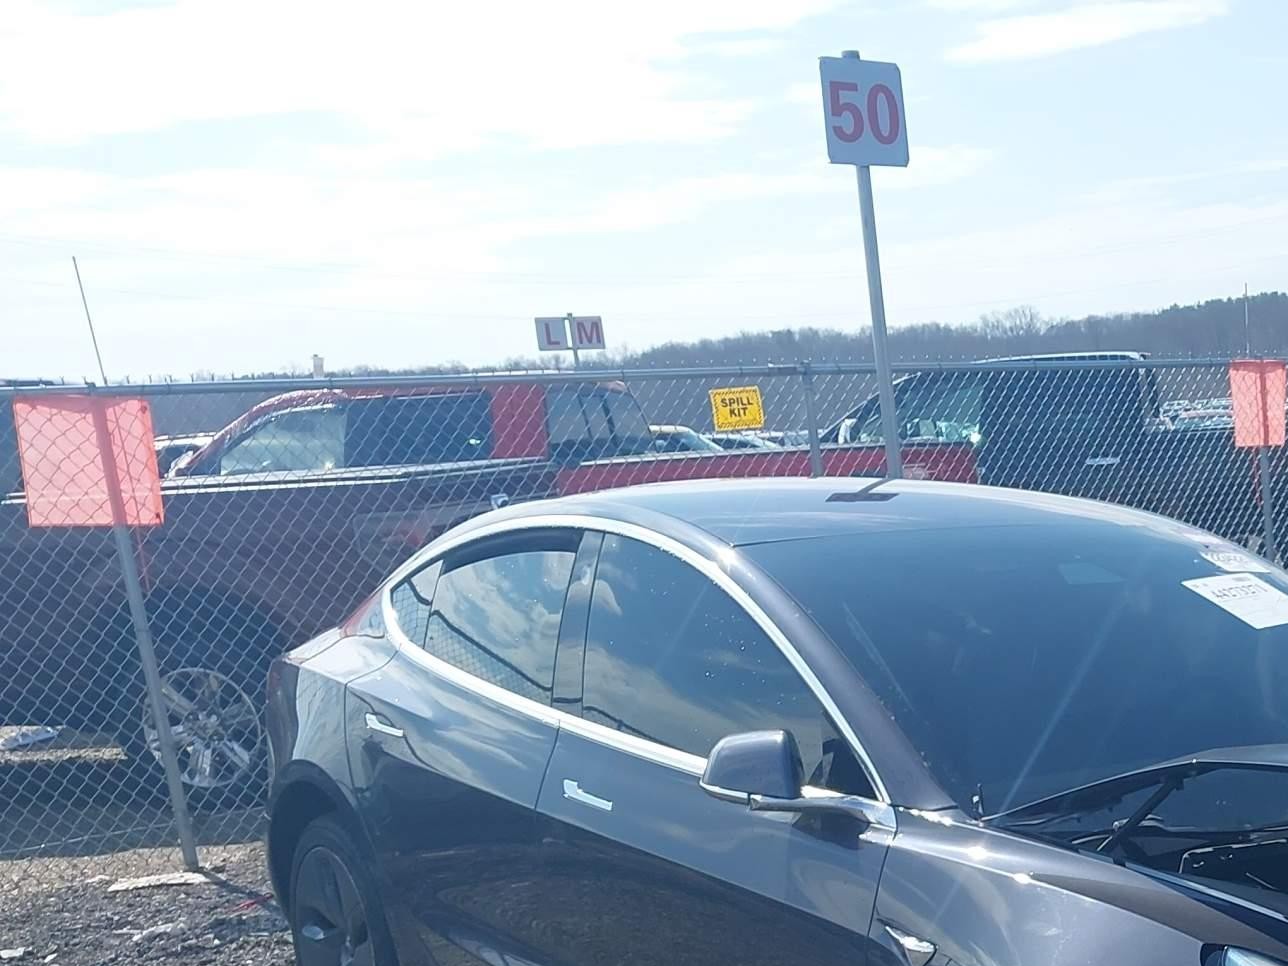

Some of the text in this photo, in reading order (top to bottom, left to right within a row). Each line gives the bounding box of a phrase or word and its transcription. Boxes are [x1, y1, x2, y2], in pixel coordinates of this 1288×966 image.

[829, 80, 899, 145] 50
[544, 322, 560, 345] L
[576, 321, 601, 344] M
[720, 396, 754, 408] SPILL
[729, 407, 748, 418] KIT
